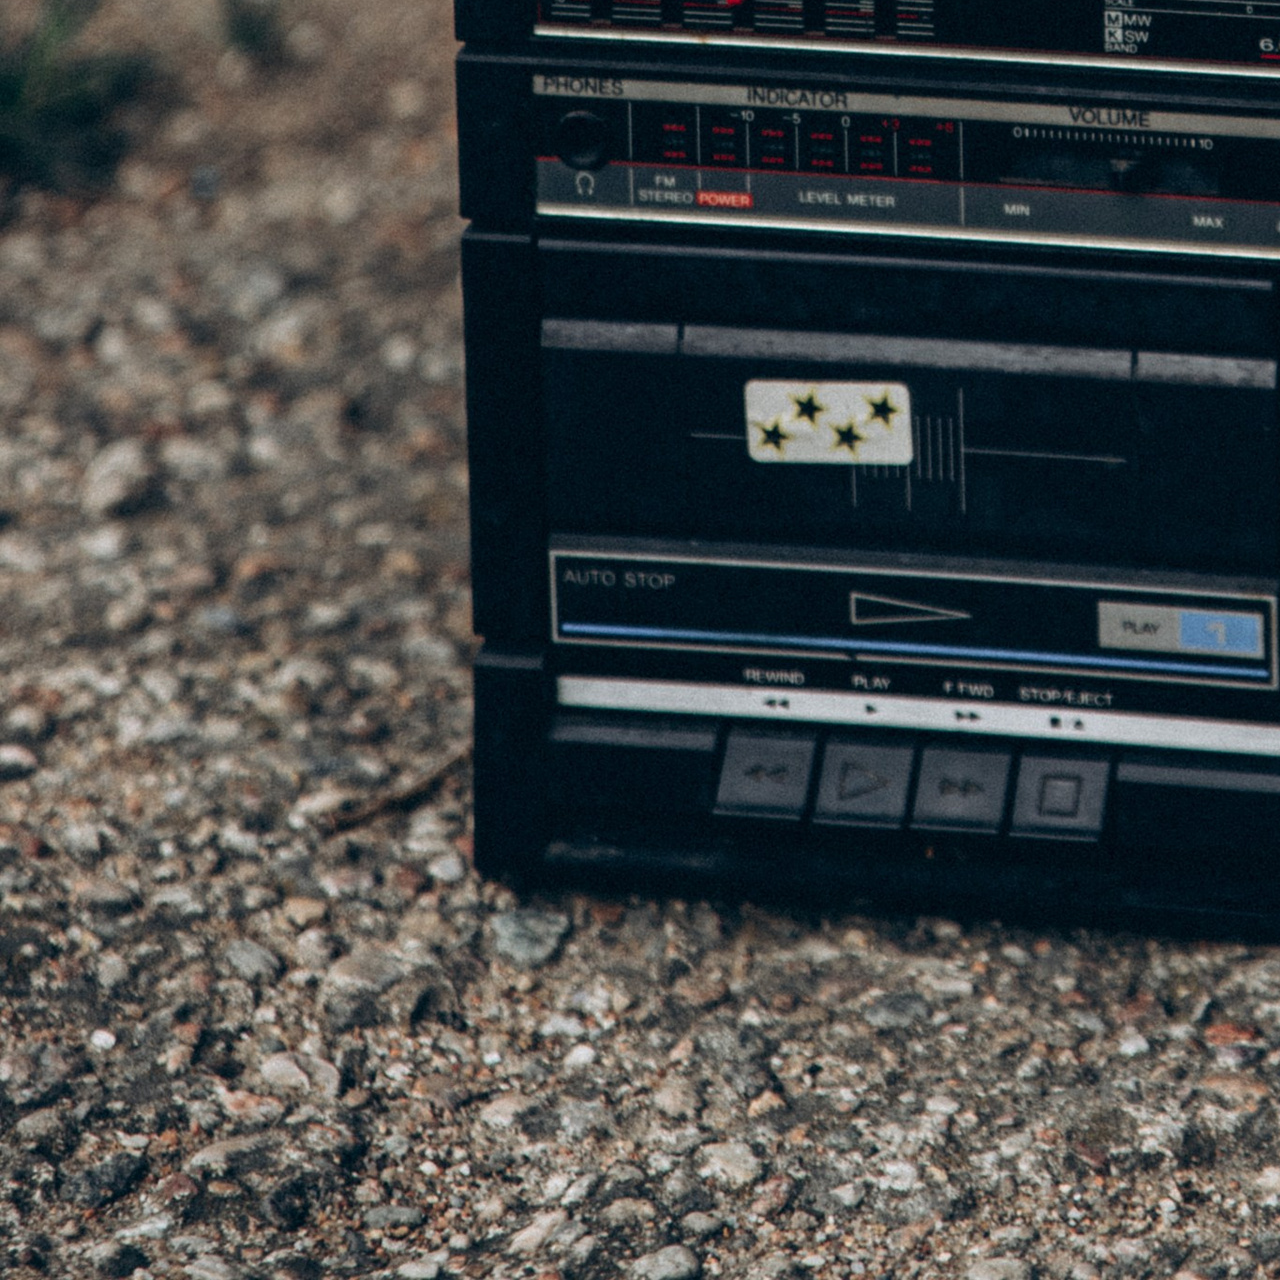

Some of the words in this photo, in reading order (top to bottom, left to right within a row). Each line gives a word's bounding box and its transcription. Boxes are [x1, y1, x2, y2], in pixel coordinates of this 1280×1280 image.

[1104, 44, 1138, 55] BAND
[543, 76, 624, 96] PHONES
[747, 86, 848, 108] INDICATOR
[841, 115, 851, 128] 0
[1069, 107, 1150, 127] VOLUME
[1013, 126, 1022, 138] 0
[1199, 139, 1214, 150] 10
[655, 175, 676, 187] FM
[639, 189, 693, 204] STEREO
[698, 193, 751, 207] POWER
[798, 191, 842, 205] LEVEL
[847, 193, 895, 207] METER
[1005, 204, 1031, 216] MIN
[1193, 216, 1224, 229] MAX
[563, 568, 616, 587] AUTO
[624, 572, 676, 590] STOP
[1122, 620, 1160, 636] PLAY
[744, 667, 805, 685] REWIND
[852, 674, 891, 691] PLAY
[1019, 685, 1113, 706] STOP/EJECT
